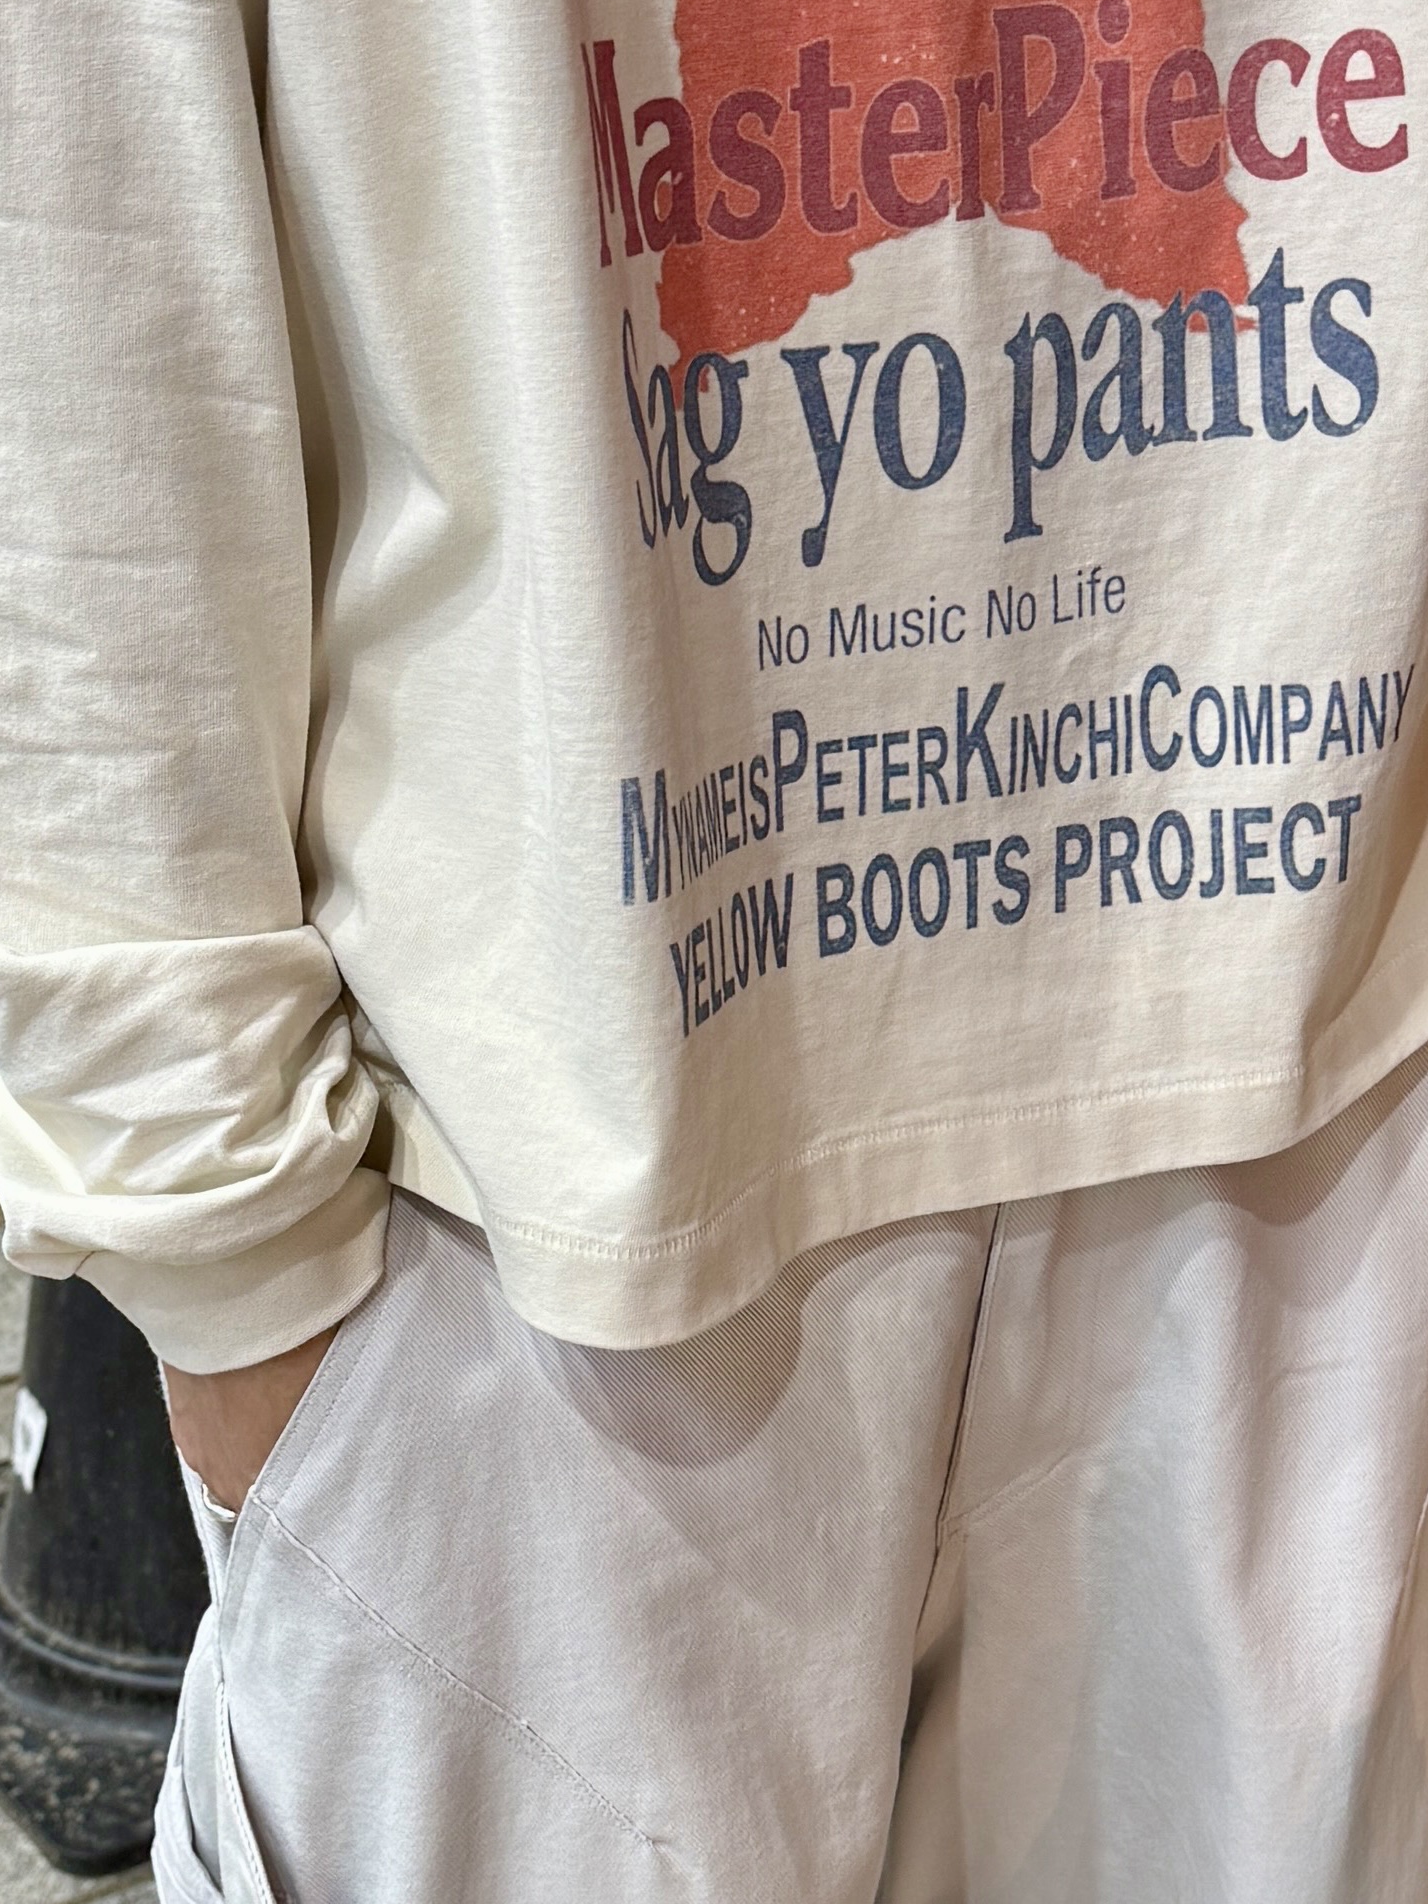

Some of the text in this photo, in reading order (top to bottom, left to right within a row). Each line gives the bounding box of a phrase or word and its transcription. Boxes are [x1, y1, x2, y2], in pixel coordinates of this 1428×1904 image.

[623, 246, 1380, 586] Sag yo pants
[758, 566, 1126, 671] No Music No Life
[669, 793, 1362, 1038] YELLOW BOOTS PROJECT
